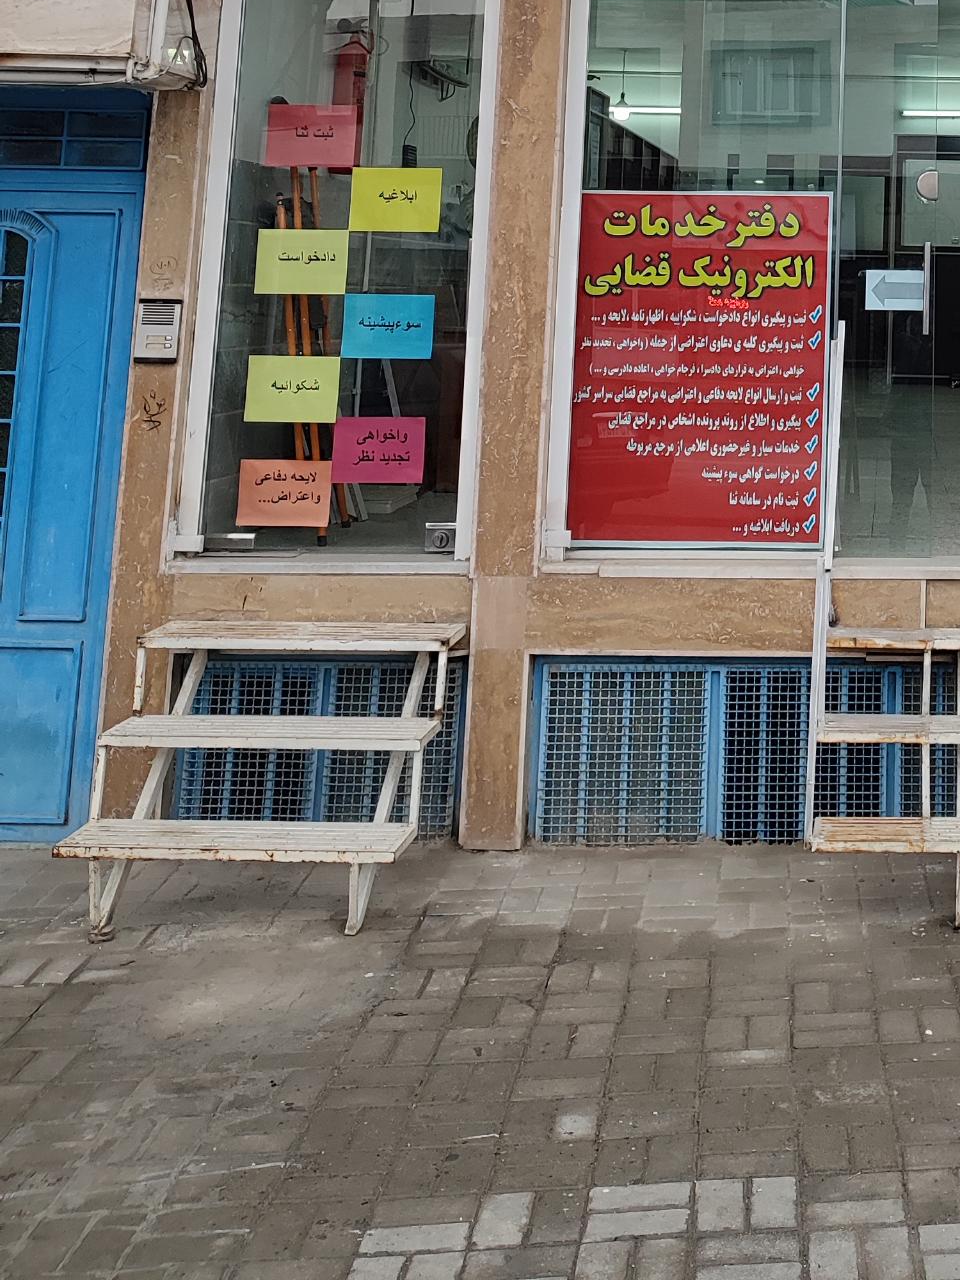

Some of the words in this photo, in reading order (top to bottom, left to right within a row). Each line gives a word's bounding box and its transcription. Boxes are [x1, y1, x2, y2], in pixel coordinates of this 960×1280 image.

[313, 125, 334, 141] ثبت
[378, 189, 418, 204] ابلاغیه
[603, 204, 726, 239] خدمات
[725, 202, 801, 248] دفتر
[278, 251, 336, 265] دادخواست
[584, 250, 671, 296] قضایی
[678, 253, 814, 299] الکترونیک
[703, 309, 740, 326] دادخواست
[742, 309, 760, 327] انواع
[761, 311, 786, 328] پیگیری
[793, 309, 807, 327] ثبت
[580, 335, 592, 349] نظر
[592, 336, 612, 350] تجدید
[649, 334, 668, 351] جمله
[669, 334, 677, 352] از
[677, 335, 708, 352] اعتراضی
[709, 335, 733, 352] دعاوی
[758, 336, 783, 353] پیگیری
[790, 334, 804, 352] ثبت
[608, 363, 633, 376] دادرسی
[722, 363, 747, 377] قرارهای
[755, 364, 779, 378] اعتراض
[783, 364, 805, 378] خواهی
[573, 385, 592, 403] کشور
[592, 385, 613, 403] سراسر
[614, 385, 636, 403] قضایی
[637, 386, 659, 403] مراجع
[660, 390, 667, 403] به
[668, 386, 697, 404] اعتراضی
[703, 385, 724, 404] دفاعی
[726, 386, 743, 403] لایحه
[744, 386, 762, 404] انواع
[763, 386, 783, 404] ارسال
[789, 386, 803, 404] ثبت
[608, 411, 632, 430] قضایی
[632, 412, 656, 430] مراجع
[657, 415, 667, 429] در
[668, 412, 695, 430] اشخاص
[696, 412, 720, 431] پرونده
[721, 412, 738, 431] روند
[740, 412, 747, 431] از
[748, 412, 770, 430] اطلاع
[776, 413, 802, 431] پیگیری
[356, 428, 408, 446] واخواهی
[626, 437, 653, 456] مربوطه
[653, 443, 675, 457] مرجع
[675, 438, 684, 456] از
[757, 439, 773, 456] سیار
[774, 439, 800, 454] خدمات
[352, 449, 375, 466] نظر
[379, 450, 410, 466] تجدید
[254, 469, 288, 486] دفاعی
[290, 471, 317, 485] لایحه
[701, 465, 723, 483] پیشینه
[738, 465, 763, 483] گواهی
[764, 465, 800, 483] درخواست
[729, 490, 738, 505] ثنا
[738, 491, 761, 505] سامانه
[761, 494, 771, 509] در
[772, 491, 784, 509] نام
[785, 491, 800, 509] ثبت
[749, 518, 772, 535] ابلاغیه
[774, 519, 800, 536] دریافت
